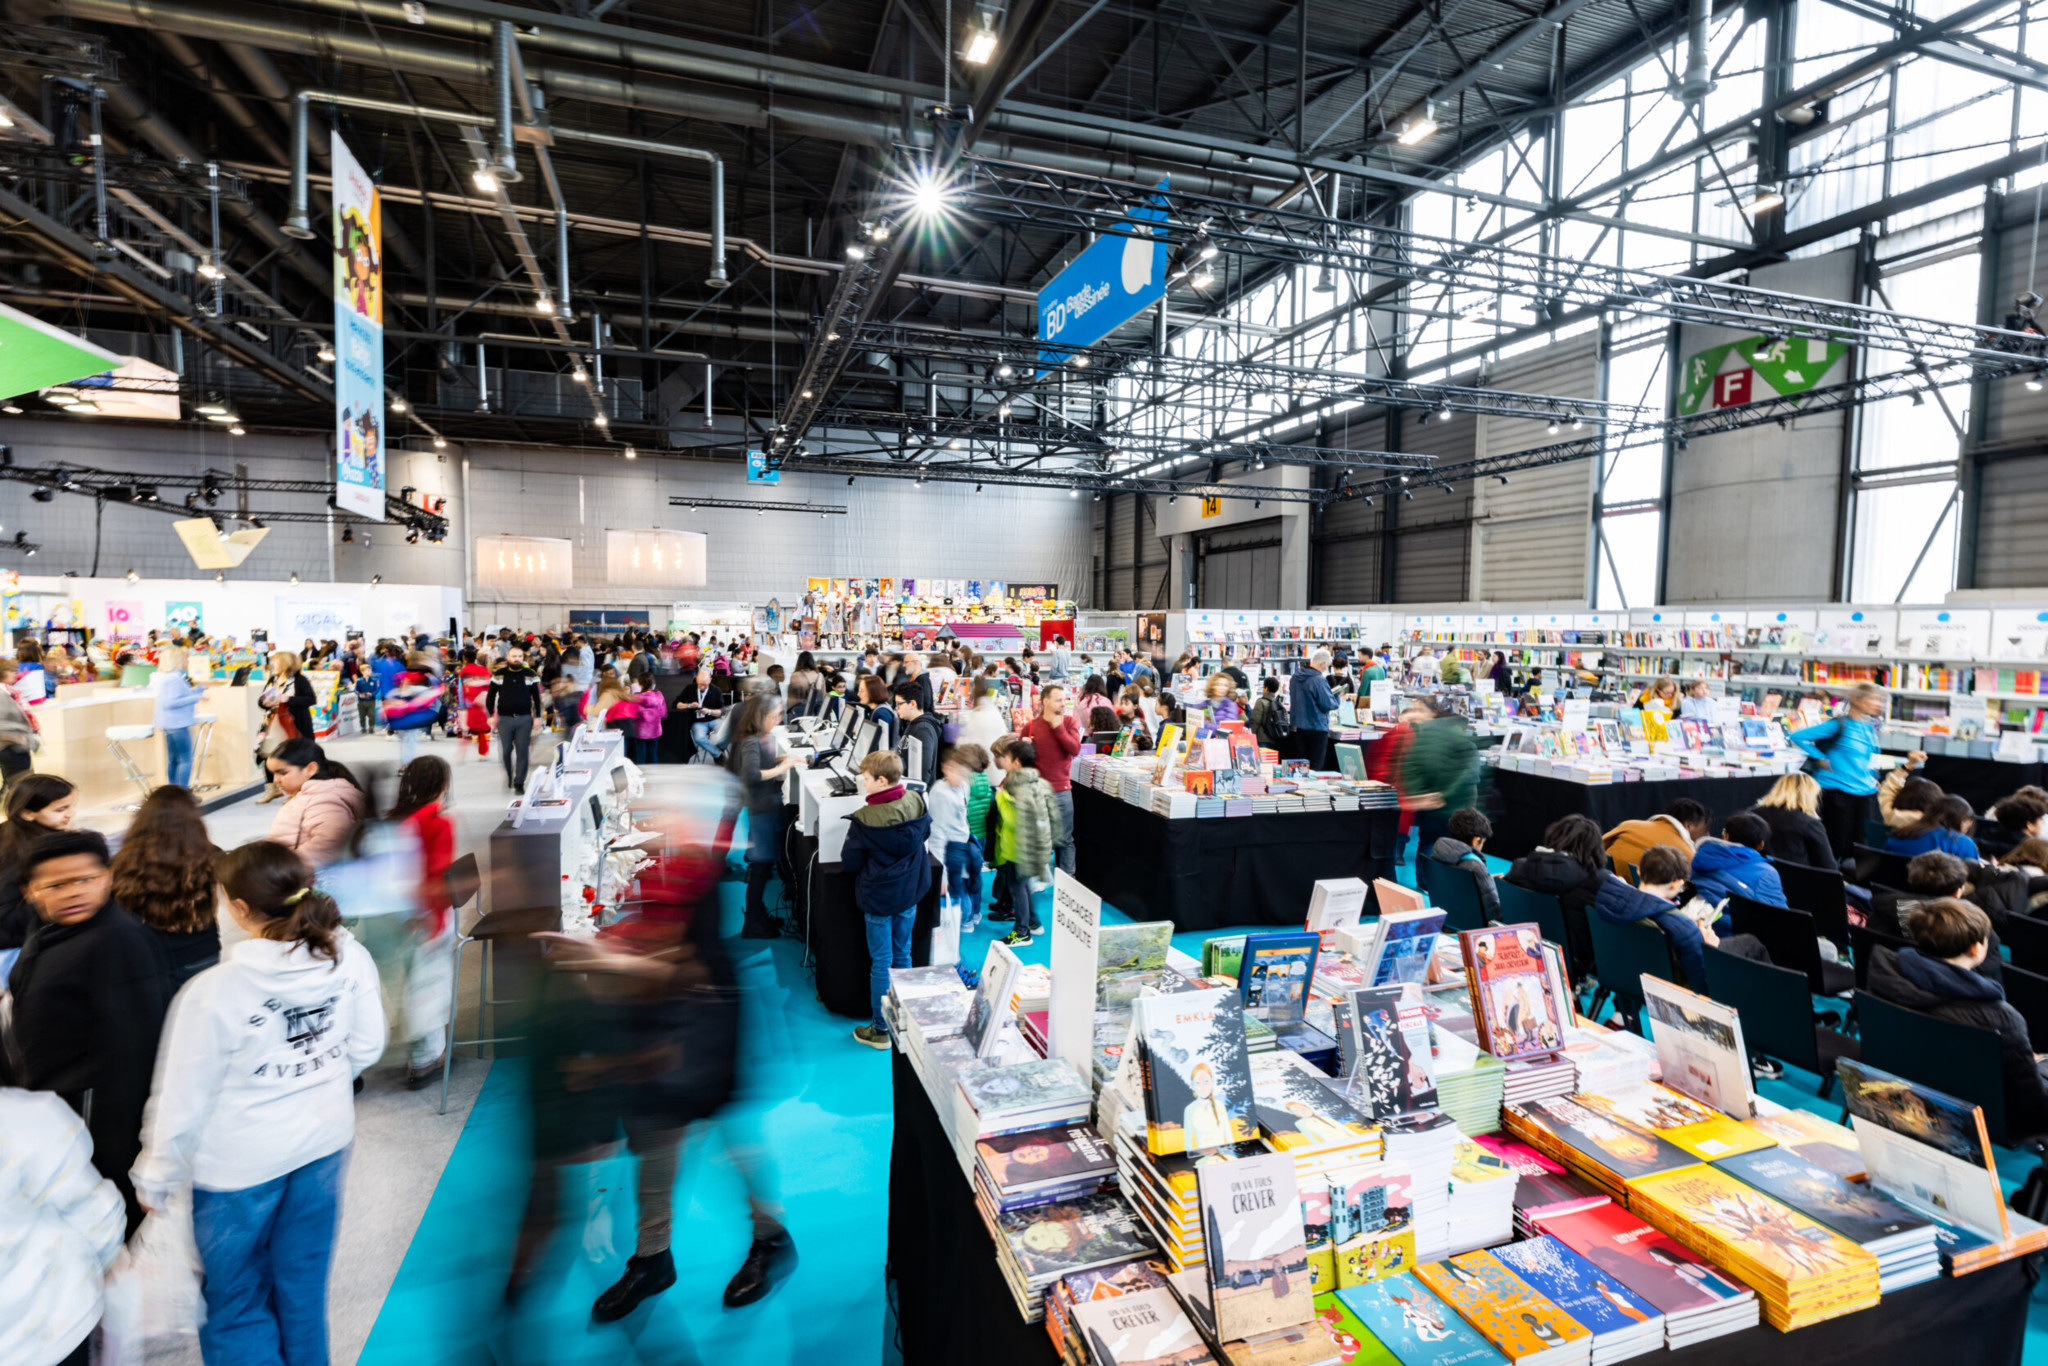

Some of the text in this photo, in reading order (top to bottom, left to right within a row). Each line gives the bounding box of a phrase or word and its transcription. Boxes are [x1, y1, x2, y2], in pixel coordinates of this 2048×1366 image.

[1066, 284, 1092, 313] Bande
[1074, 281, 1110, 319] dessinée
[1047, 303, 1066, 340] BD
[1723, 372, 1744, 402] F
[109, 608, 129, 622] 10
[1057, 887, 1094, 927] DÉDICACES
[1057, 910, 1092, 949] BD ADULTE
[1176, 1011, 1216, 1025] EMKLA
[1254, 1176, 1272, 1188] TOUS
[1233, 1189, 1275, 1214] CREVER
[1112, 1310, 1160, 1331] CREVER
